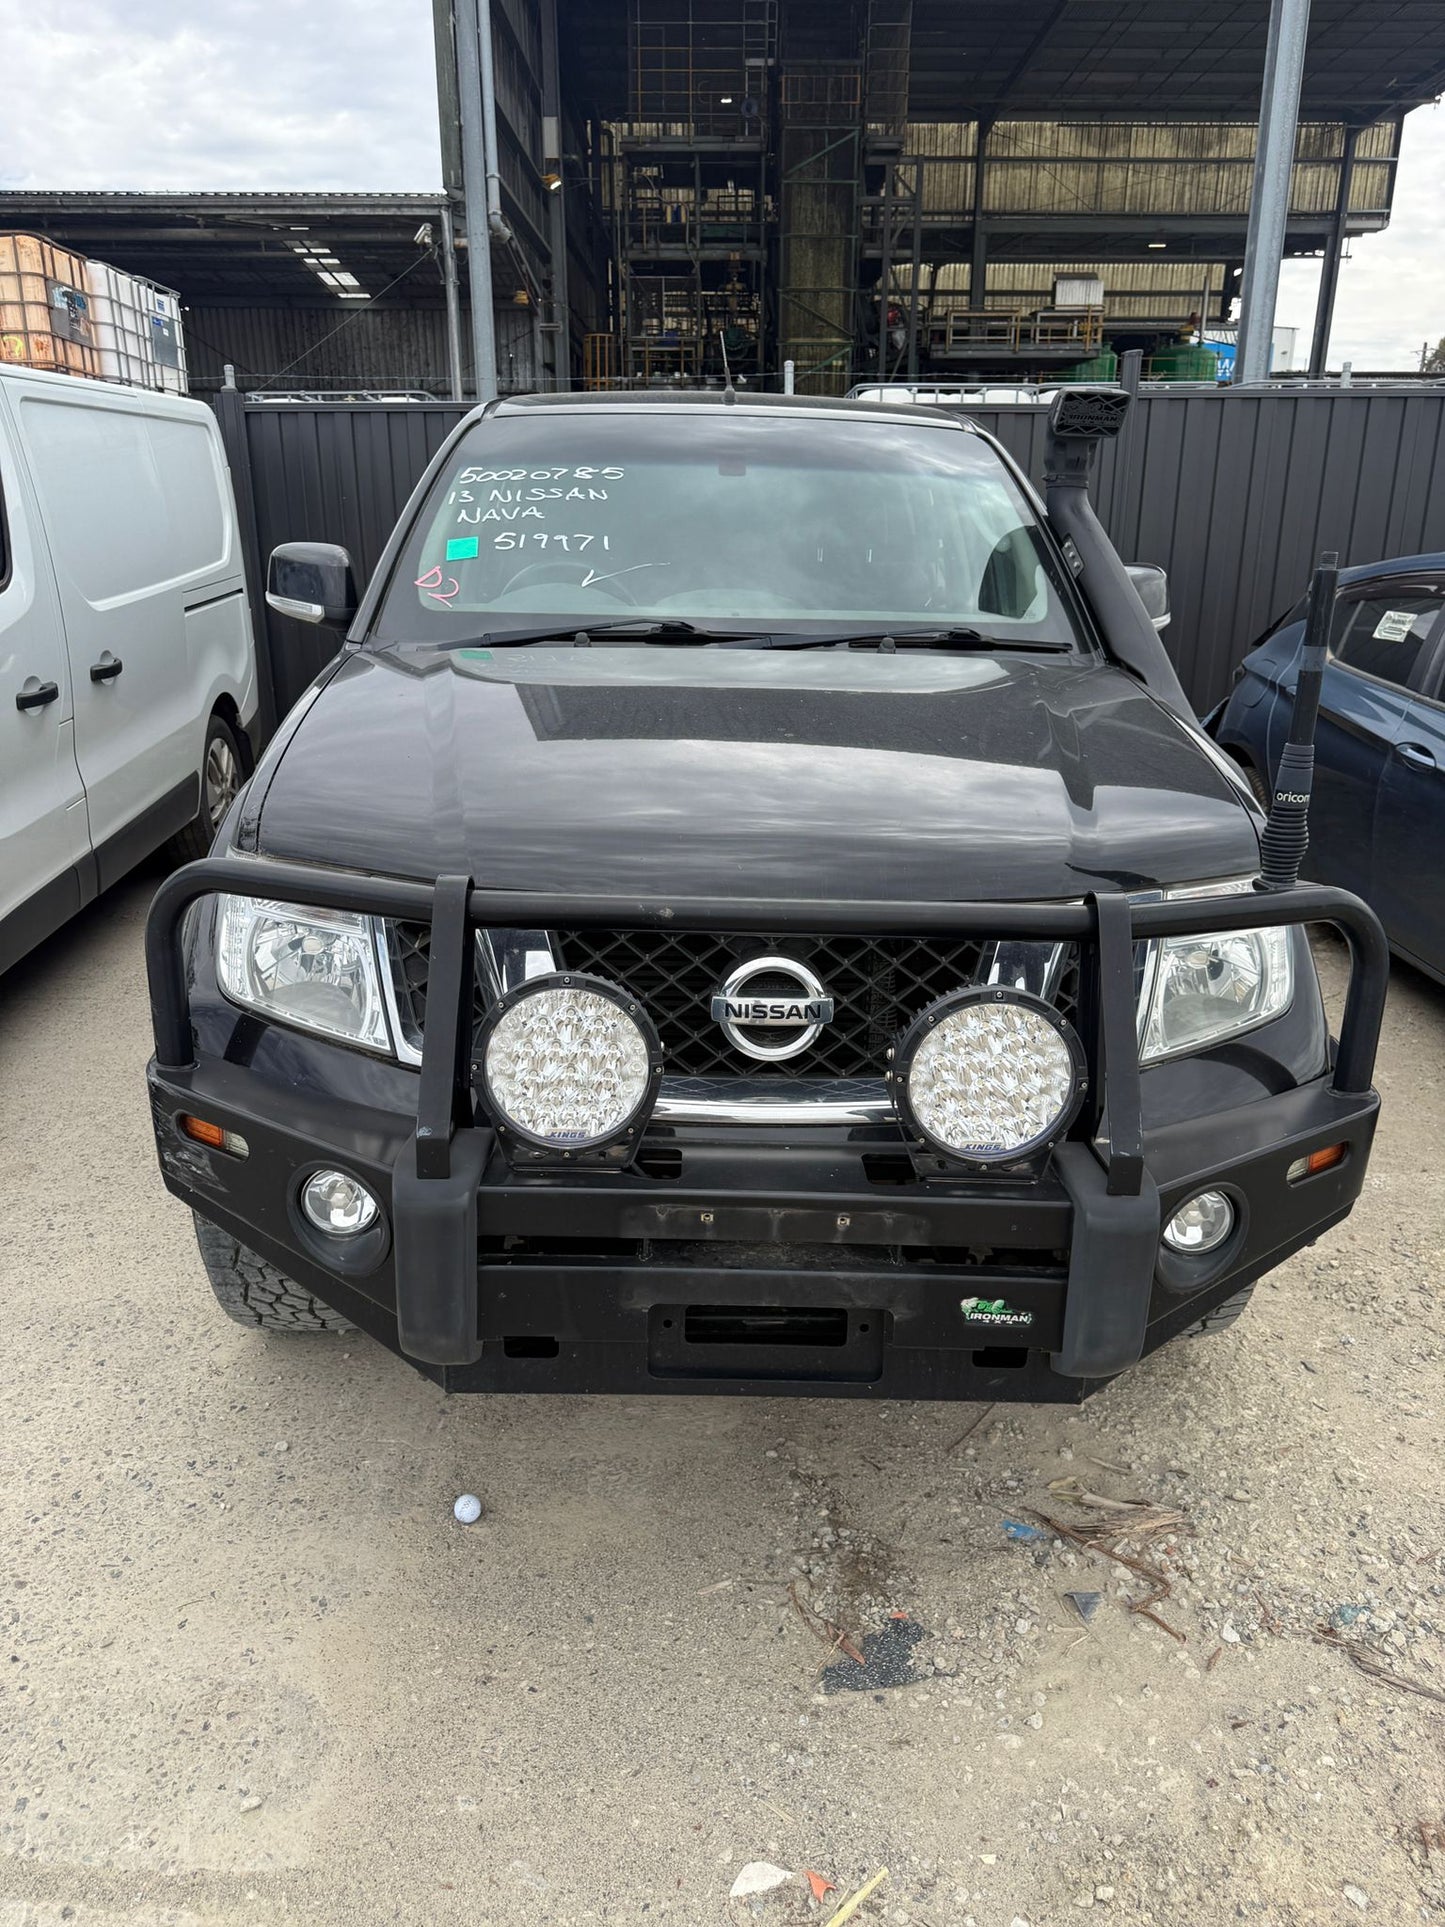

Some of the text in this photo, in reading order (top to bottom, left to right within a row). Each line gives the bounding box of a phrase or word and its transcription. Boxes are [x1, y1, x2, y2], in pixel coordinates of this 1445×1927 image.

[459, 467, 625, 484] 50020785
[448, 487, 608, 505] 13 NISSAN
[456, 506, 546, 524] NAVA
[494, 532, 610, 551] 519971
[724, 1003, 821, 1020] NISSAN
[970, 1312, 1029, 1322] IRONMAN
